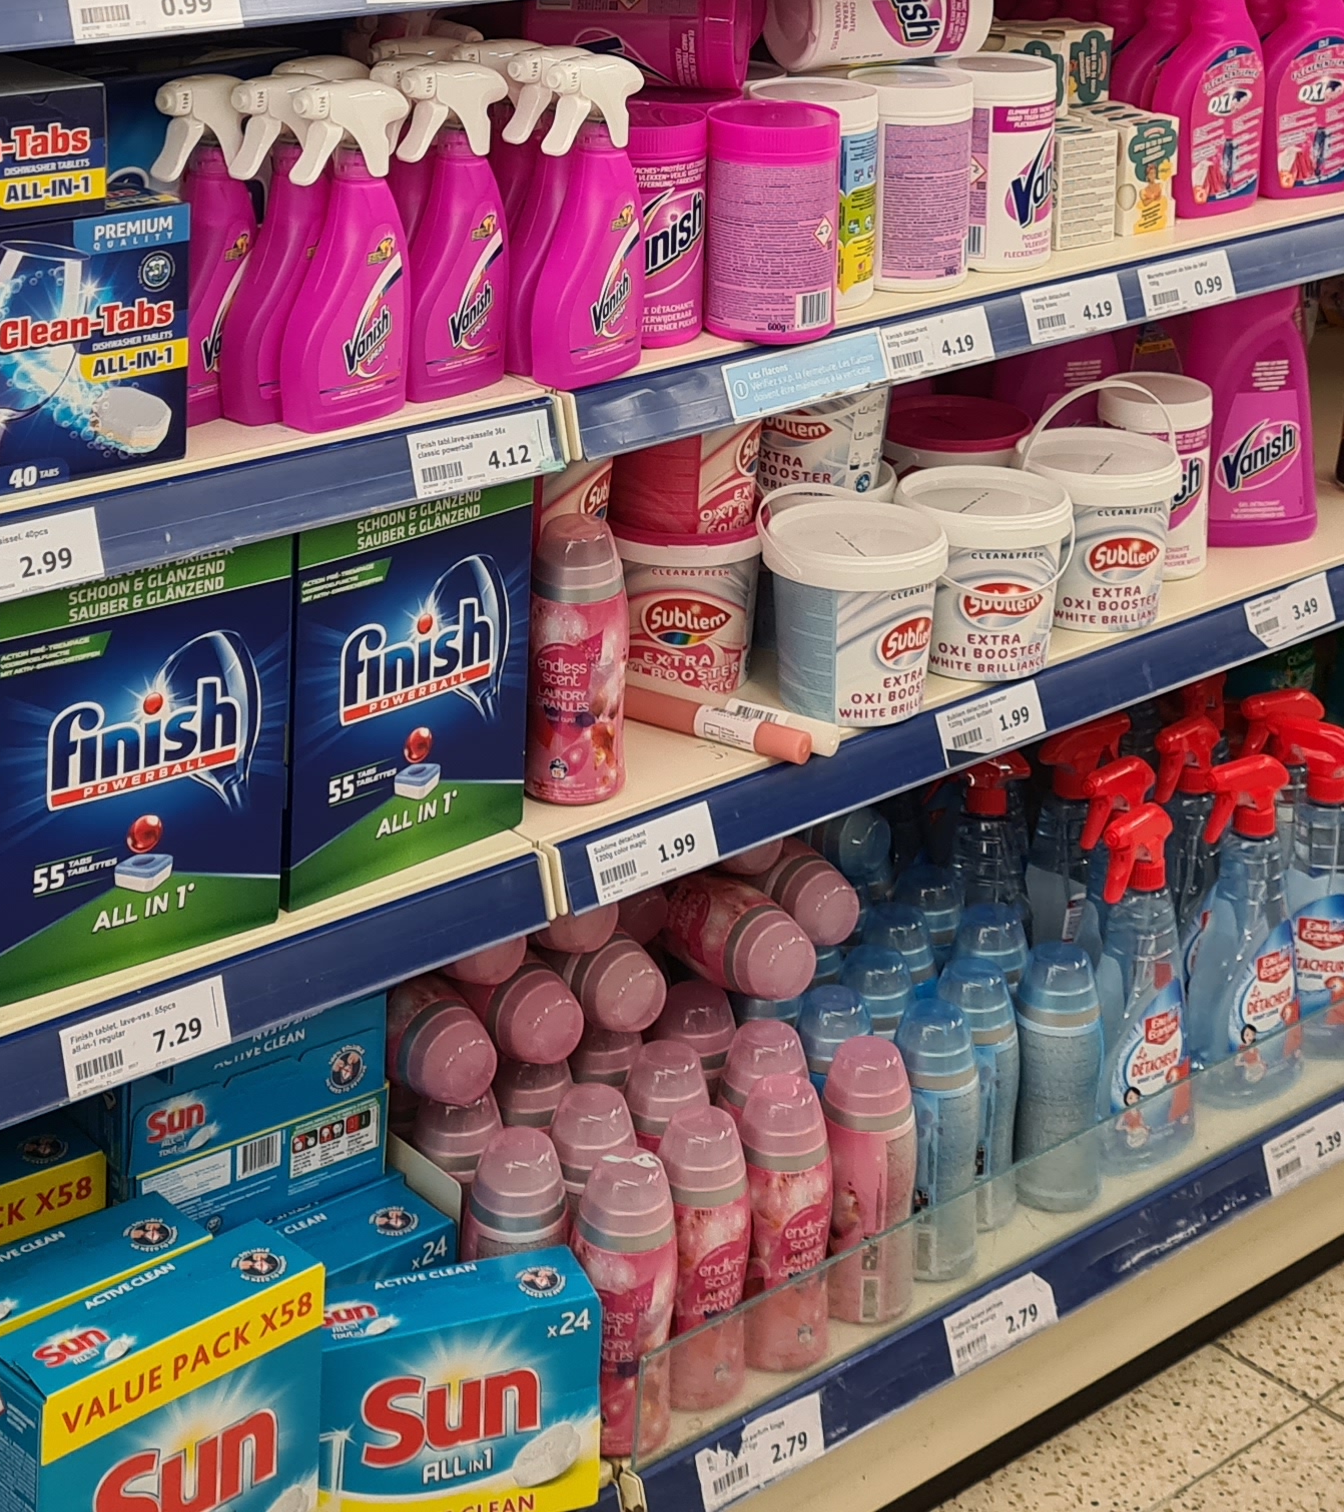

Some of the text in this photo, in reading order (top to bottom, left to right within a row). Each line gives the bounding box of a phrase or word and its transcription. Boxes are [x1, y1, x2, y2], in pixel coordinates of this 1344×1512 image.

[3, 157, 91, 177] DISHWASHER TABLETS
[4, 175, 91, 204] ALL-IN-1
[94, 215, 173, 241] PREMIUM
[342, 303, 393, 375] Vanish
[488, 445, 531, 469] 4.12
[20, 547, 72, 578] 2.99
[646, 602, 730, 633] Subliem
[938, 642, 1042, 658] OXI BOOSTER
[966, 632, 1022, 646] EXTRA
[536, 655, 588, 676] endless
[928, 655, 972, 672] WHITE
[542, 670, 580, 688] scent
[153, 1017, 202, 1054] 7.29
[546, 1307, 592, 1342] x24
[62, 1291, 315, 1435] VALUE PACK X58
[360, 1367, 542, 1469] Sun
